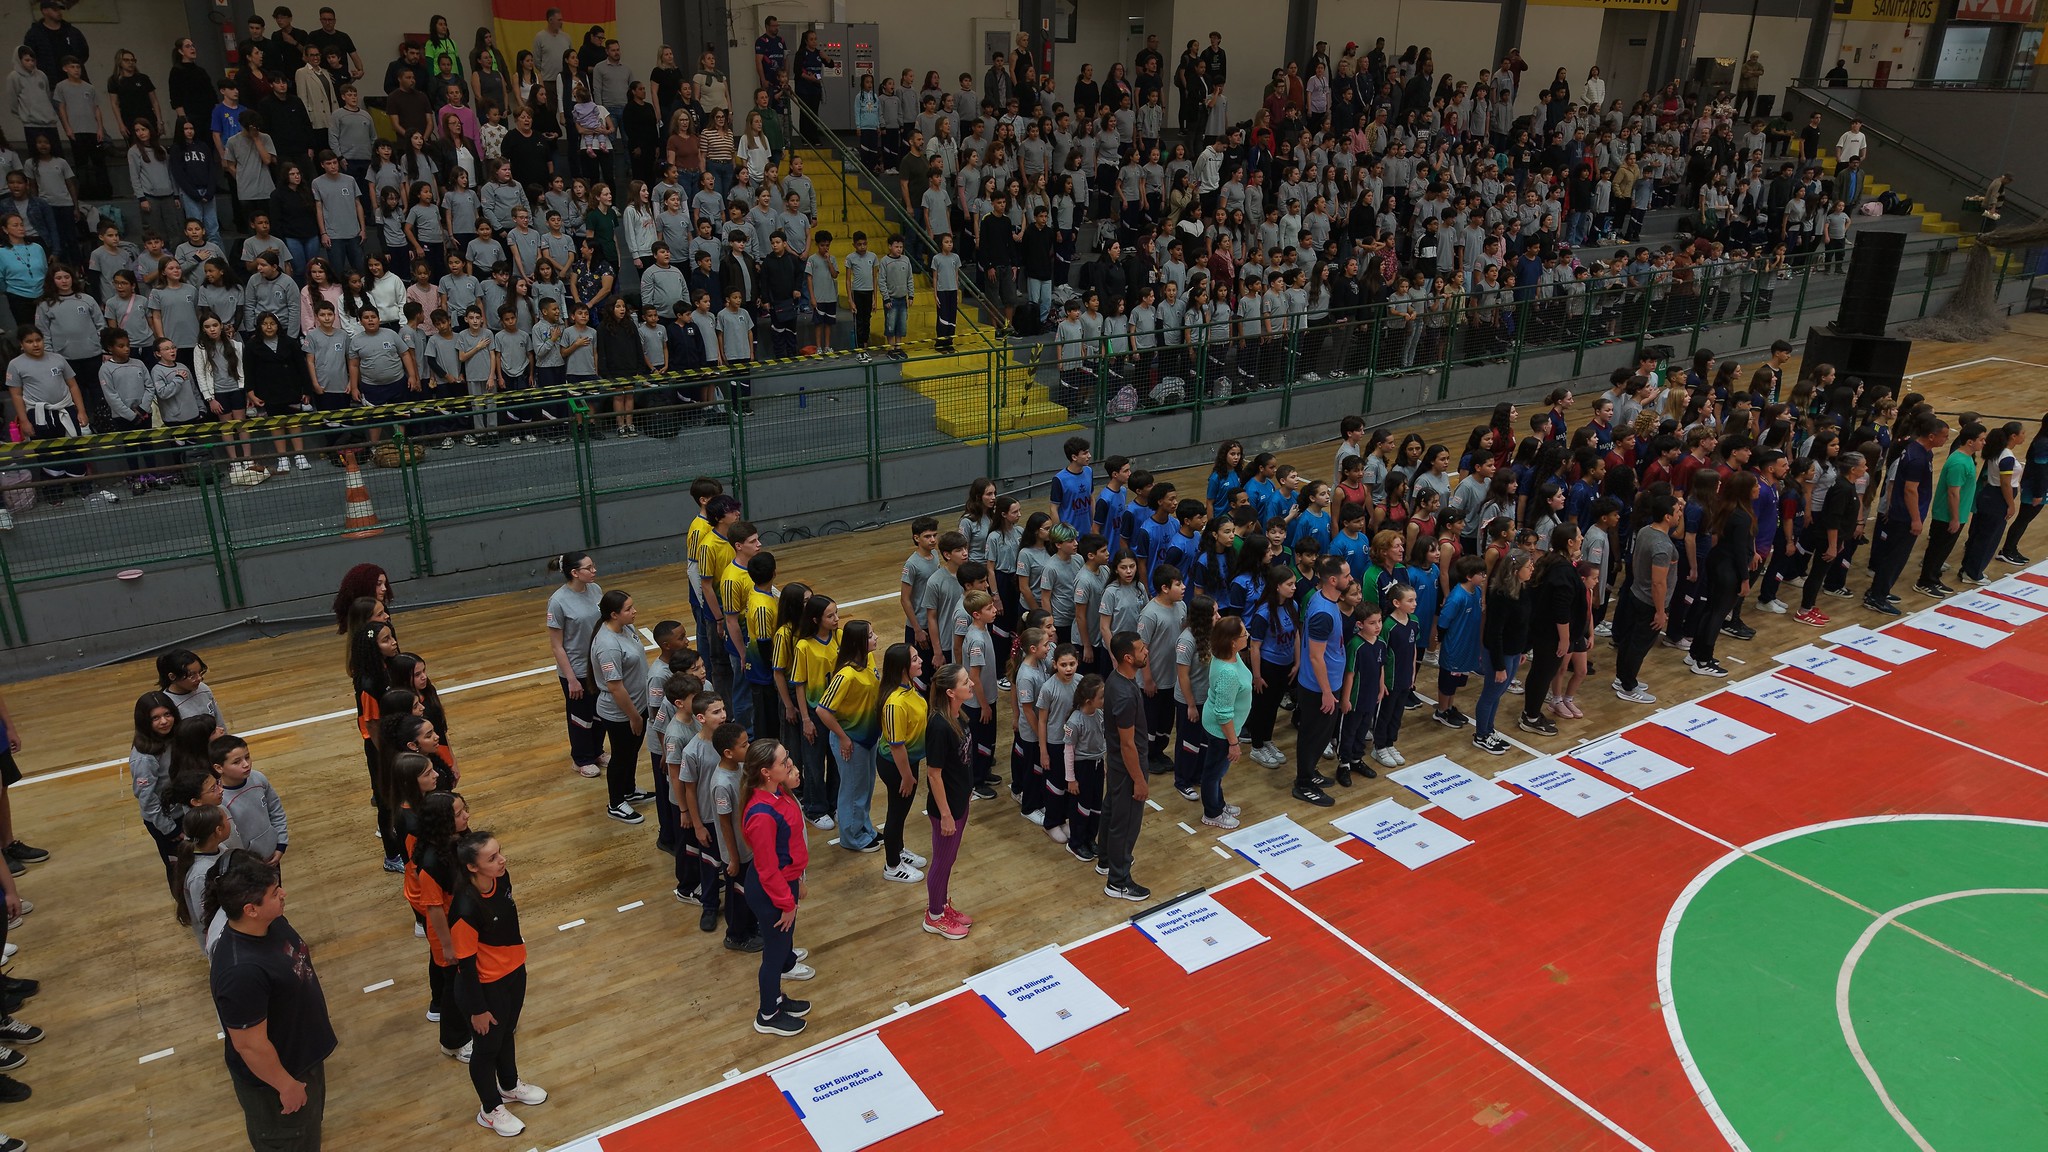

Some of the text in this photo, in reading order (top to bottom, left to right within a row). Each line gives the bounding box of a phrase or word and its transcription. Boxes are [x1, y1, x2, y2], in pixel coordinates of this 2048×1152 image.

[1438, 774, 1461, 784] Norma
[1452, 778, 1472, 787] Huber
[1253, 833, 1289, 849] EBM Bilingue
[1376, 832, 1393, 841] Oscar
[1258, 837, 1299, 854] Prof. Fernando
[1270, 843, 1302, 857] Ostermann
[1155, 907, 1208, 930] Bilingue Patricia
[1166, 908, 1182, 917] EBM
[1161, 924, 1186, 936] Helena
[1190, 911, 1218, 925] Pegorim
[1007, 974, 1054, 996] EBM Bilingue
[1016, 980, 1061, 1002] Olga Rutzen
[812, 1070, 883, 1103] Gustavo Richard
[813, 1067, 869, 1093] EBM Bilingue
